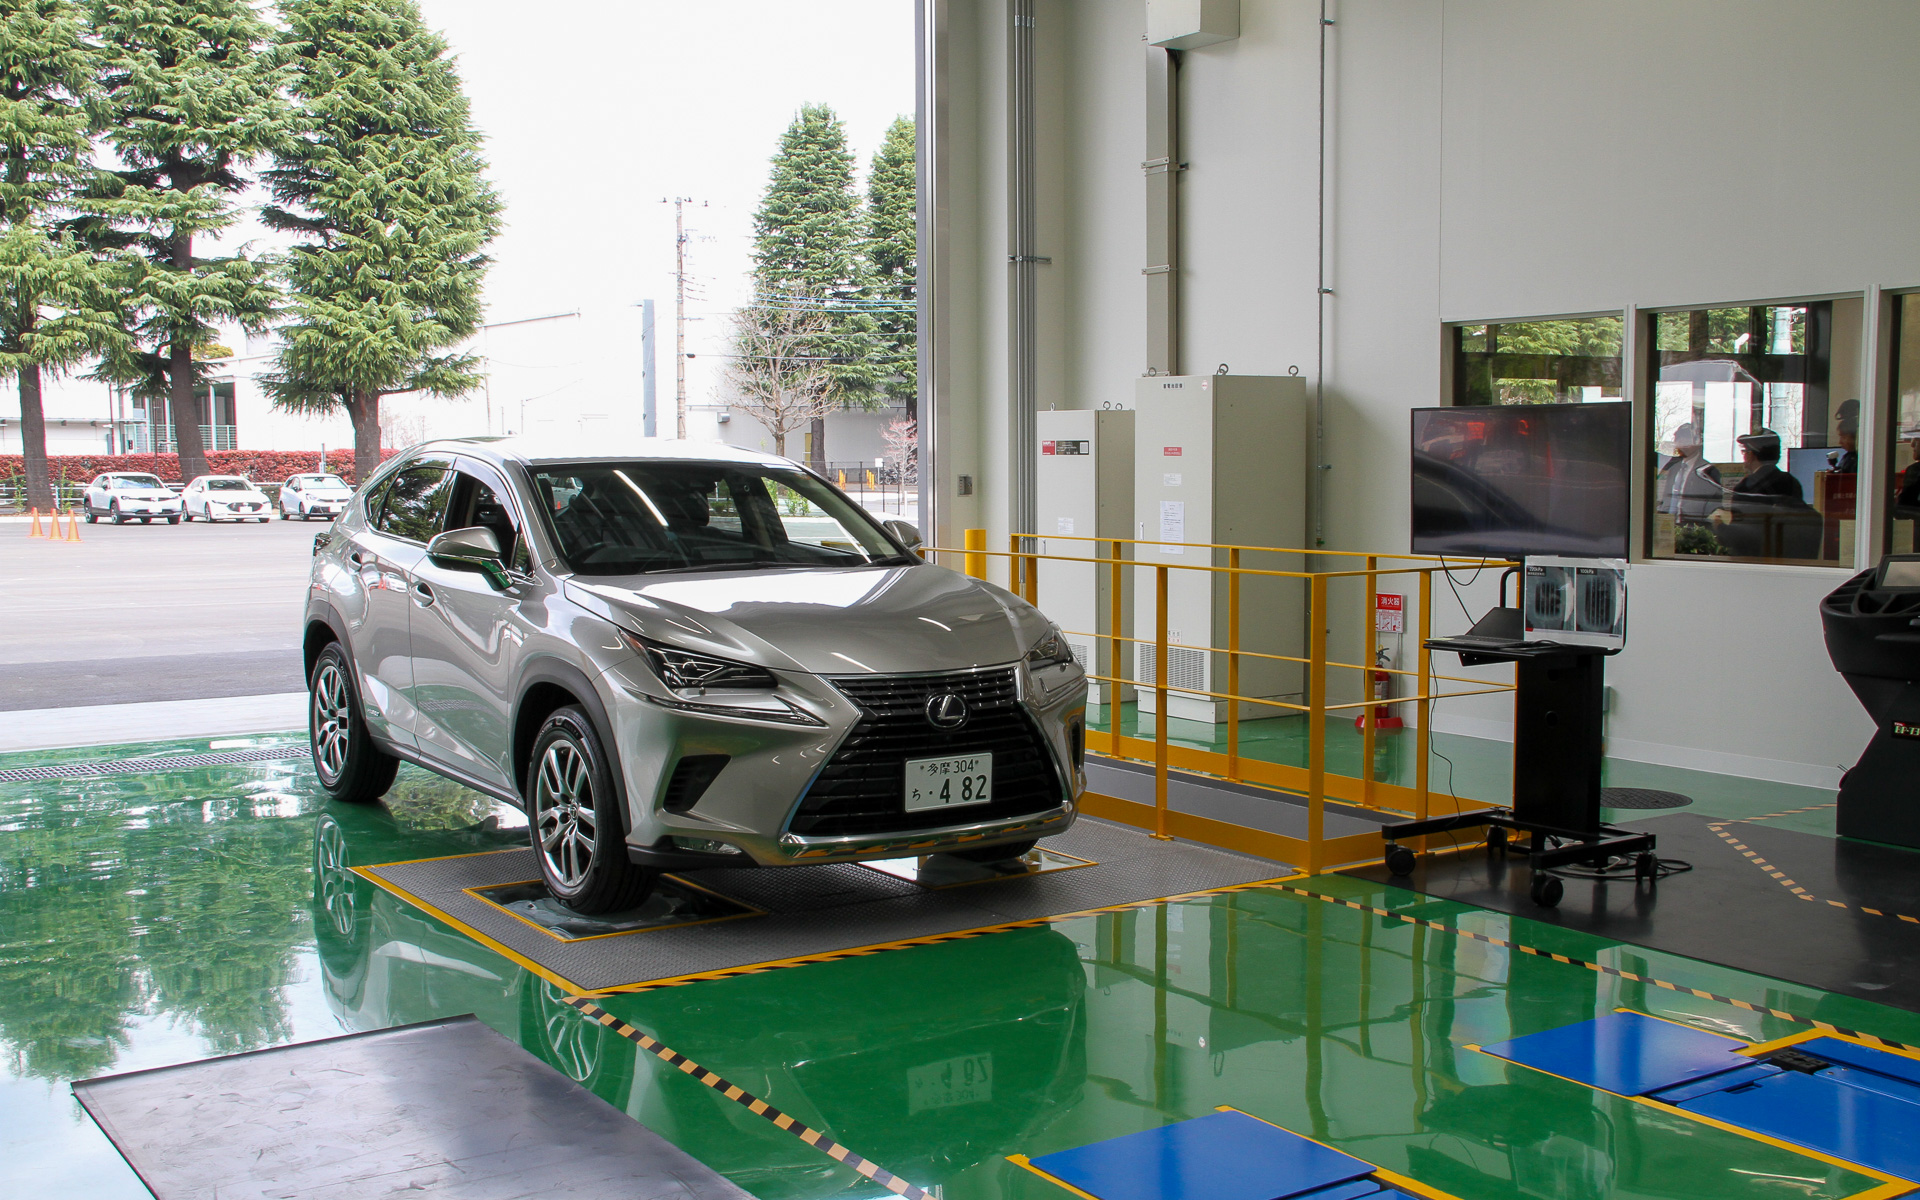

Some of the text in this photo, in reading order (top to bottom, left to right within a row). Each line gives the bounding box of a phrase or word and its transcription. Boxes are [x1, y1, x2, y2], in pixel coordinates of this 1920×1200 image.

[1381, 597, 1400, 606] 消火器
[927, 759, 974, 776] 多摩 304
[912, 788, 921, 801] ち
